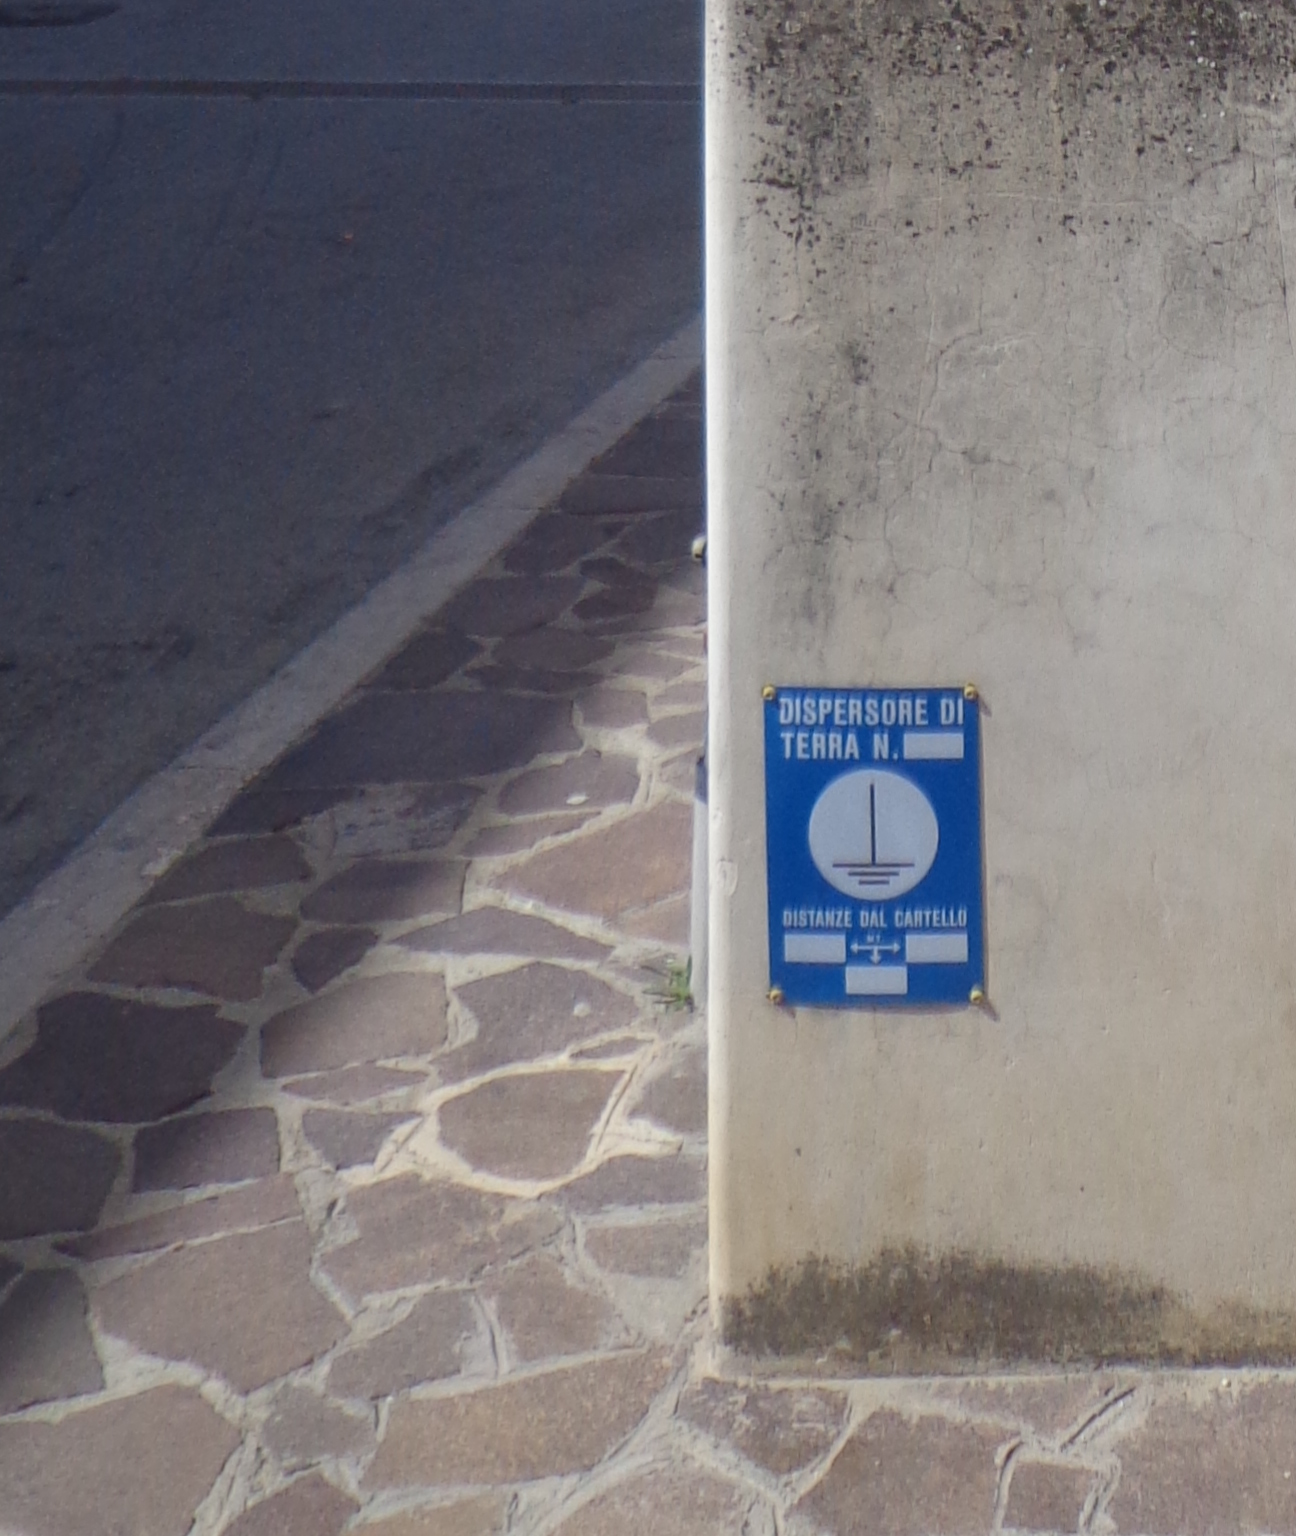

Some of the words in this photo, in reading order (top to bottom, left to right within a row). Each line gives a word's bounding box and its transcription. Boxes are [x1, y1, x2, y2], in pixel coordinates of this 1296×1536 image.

[779, 698, 928, 726] DISPERSORE
[941, 698, 964, 725] DI
[780, 732, 859, 759] TERRA
[873, 732, 900, 759] N.
[782, 910, 852, 927] DISTANZE
[860, 910, 887, 928] DAL
[895, 910, 967, 927] CARTELLO
